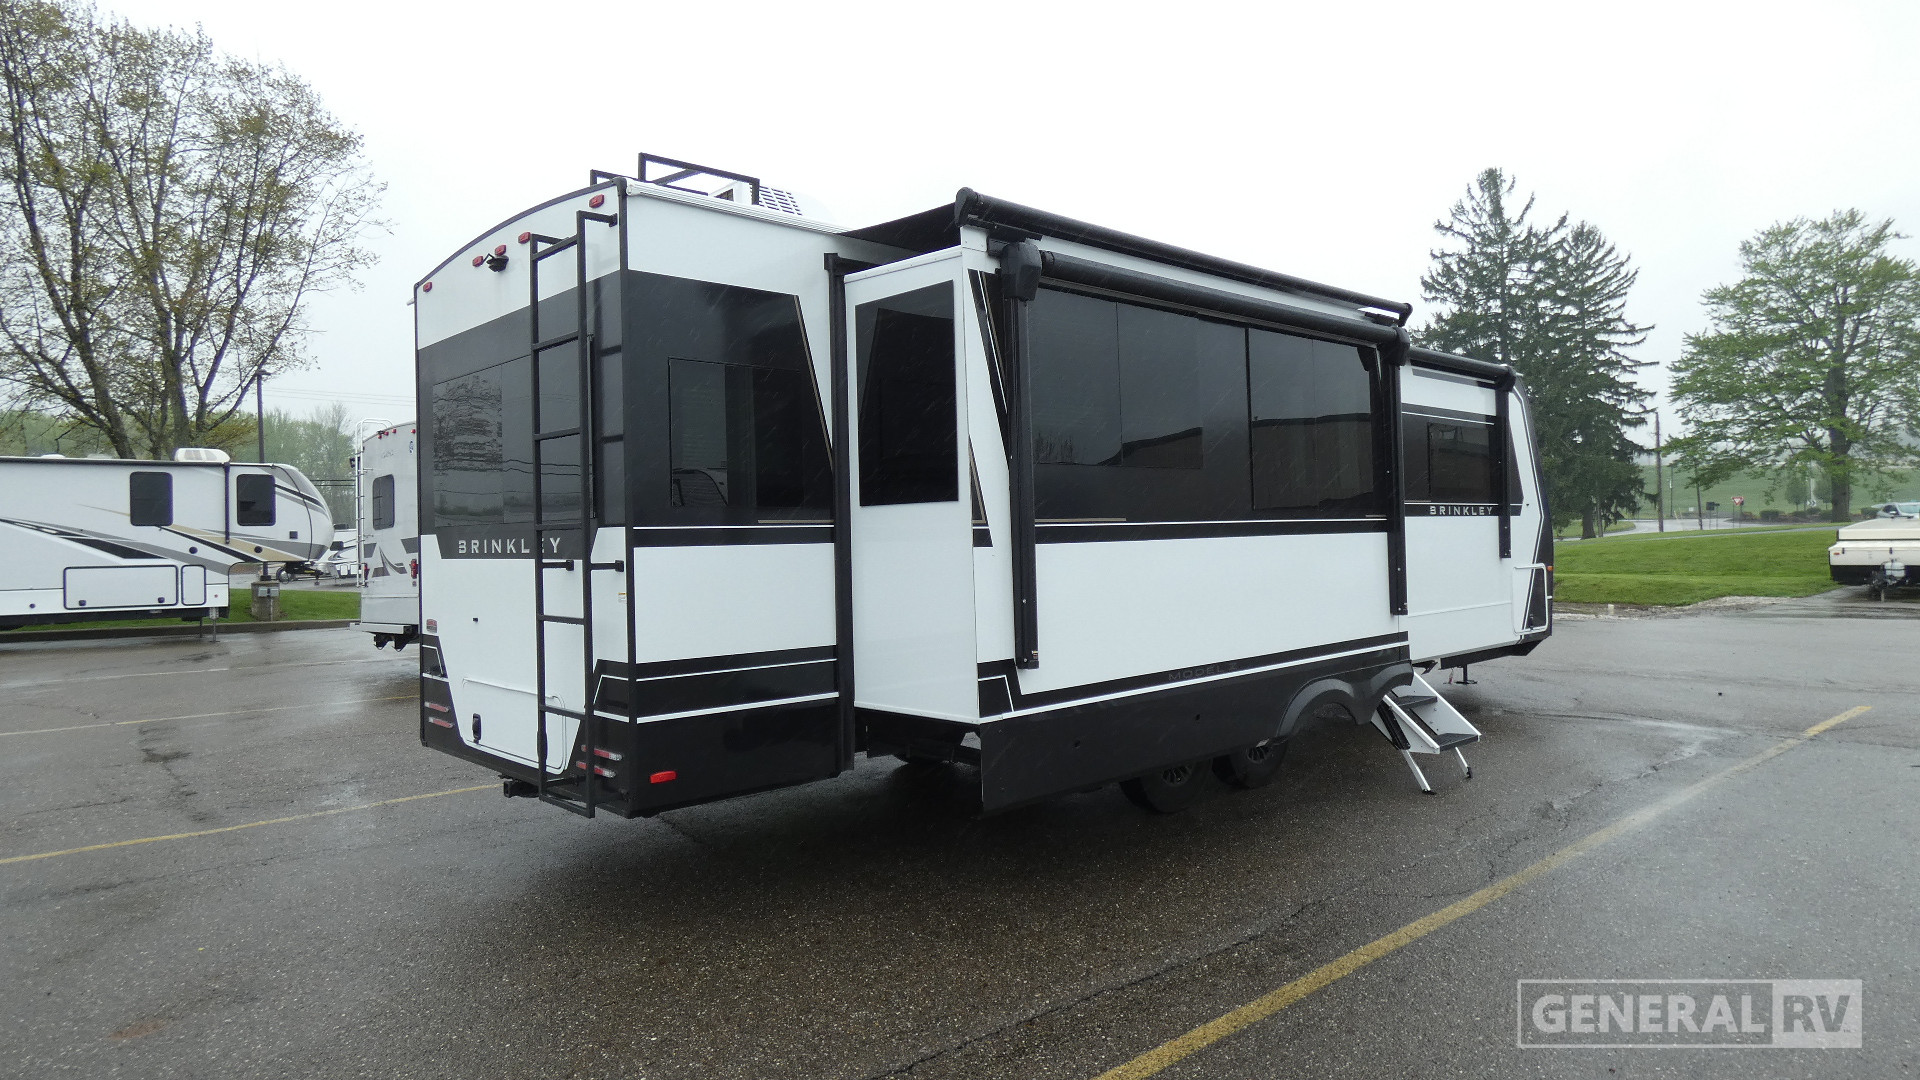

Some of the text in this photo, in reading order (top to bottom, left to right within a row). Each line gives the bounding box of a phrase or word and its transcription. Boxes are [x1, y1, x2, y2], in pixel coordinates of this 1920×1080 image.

[1429, 505, 1493, 516] BRINKLEY
[458, 537, 561, 554] BRINKLY
[1168, 665, 1223, 681] MODEL
